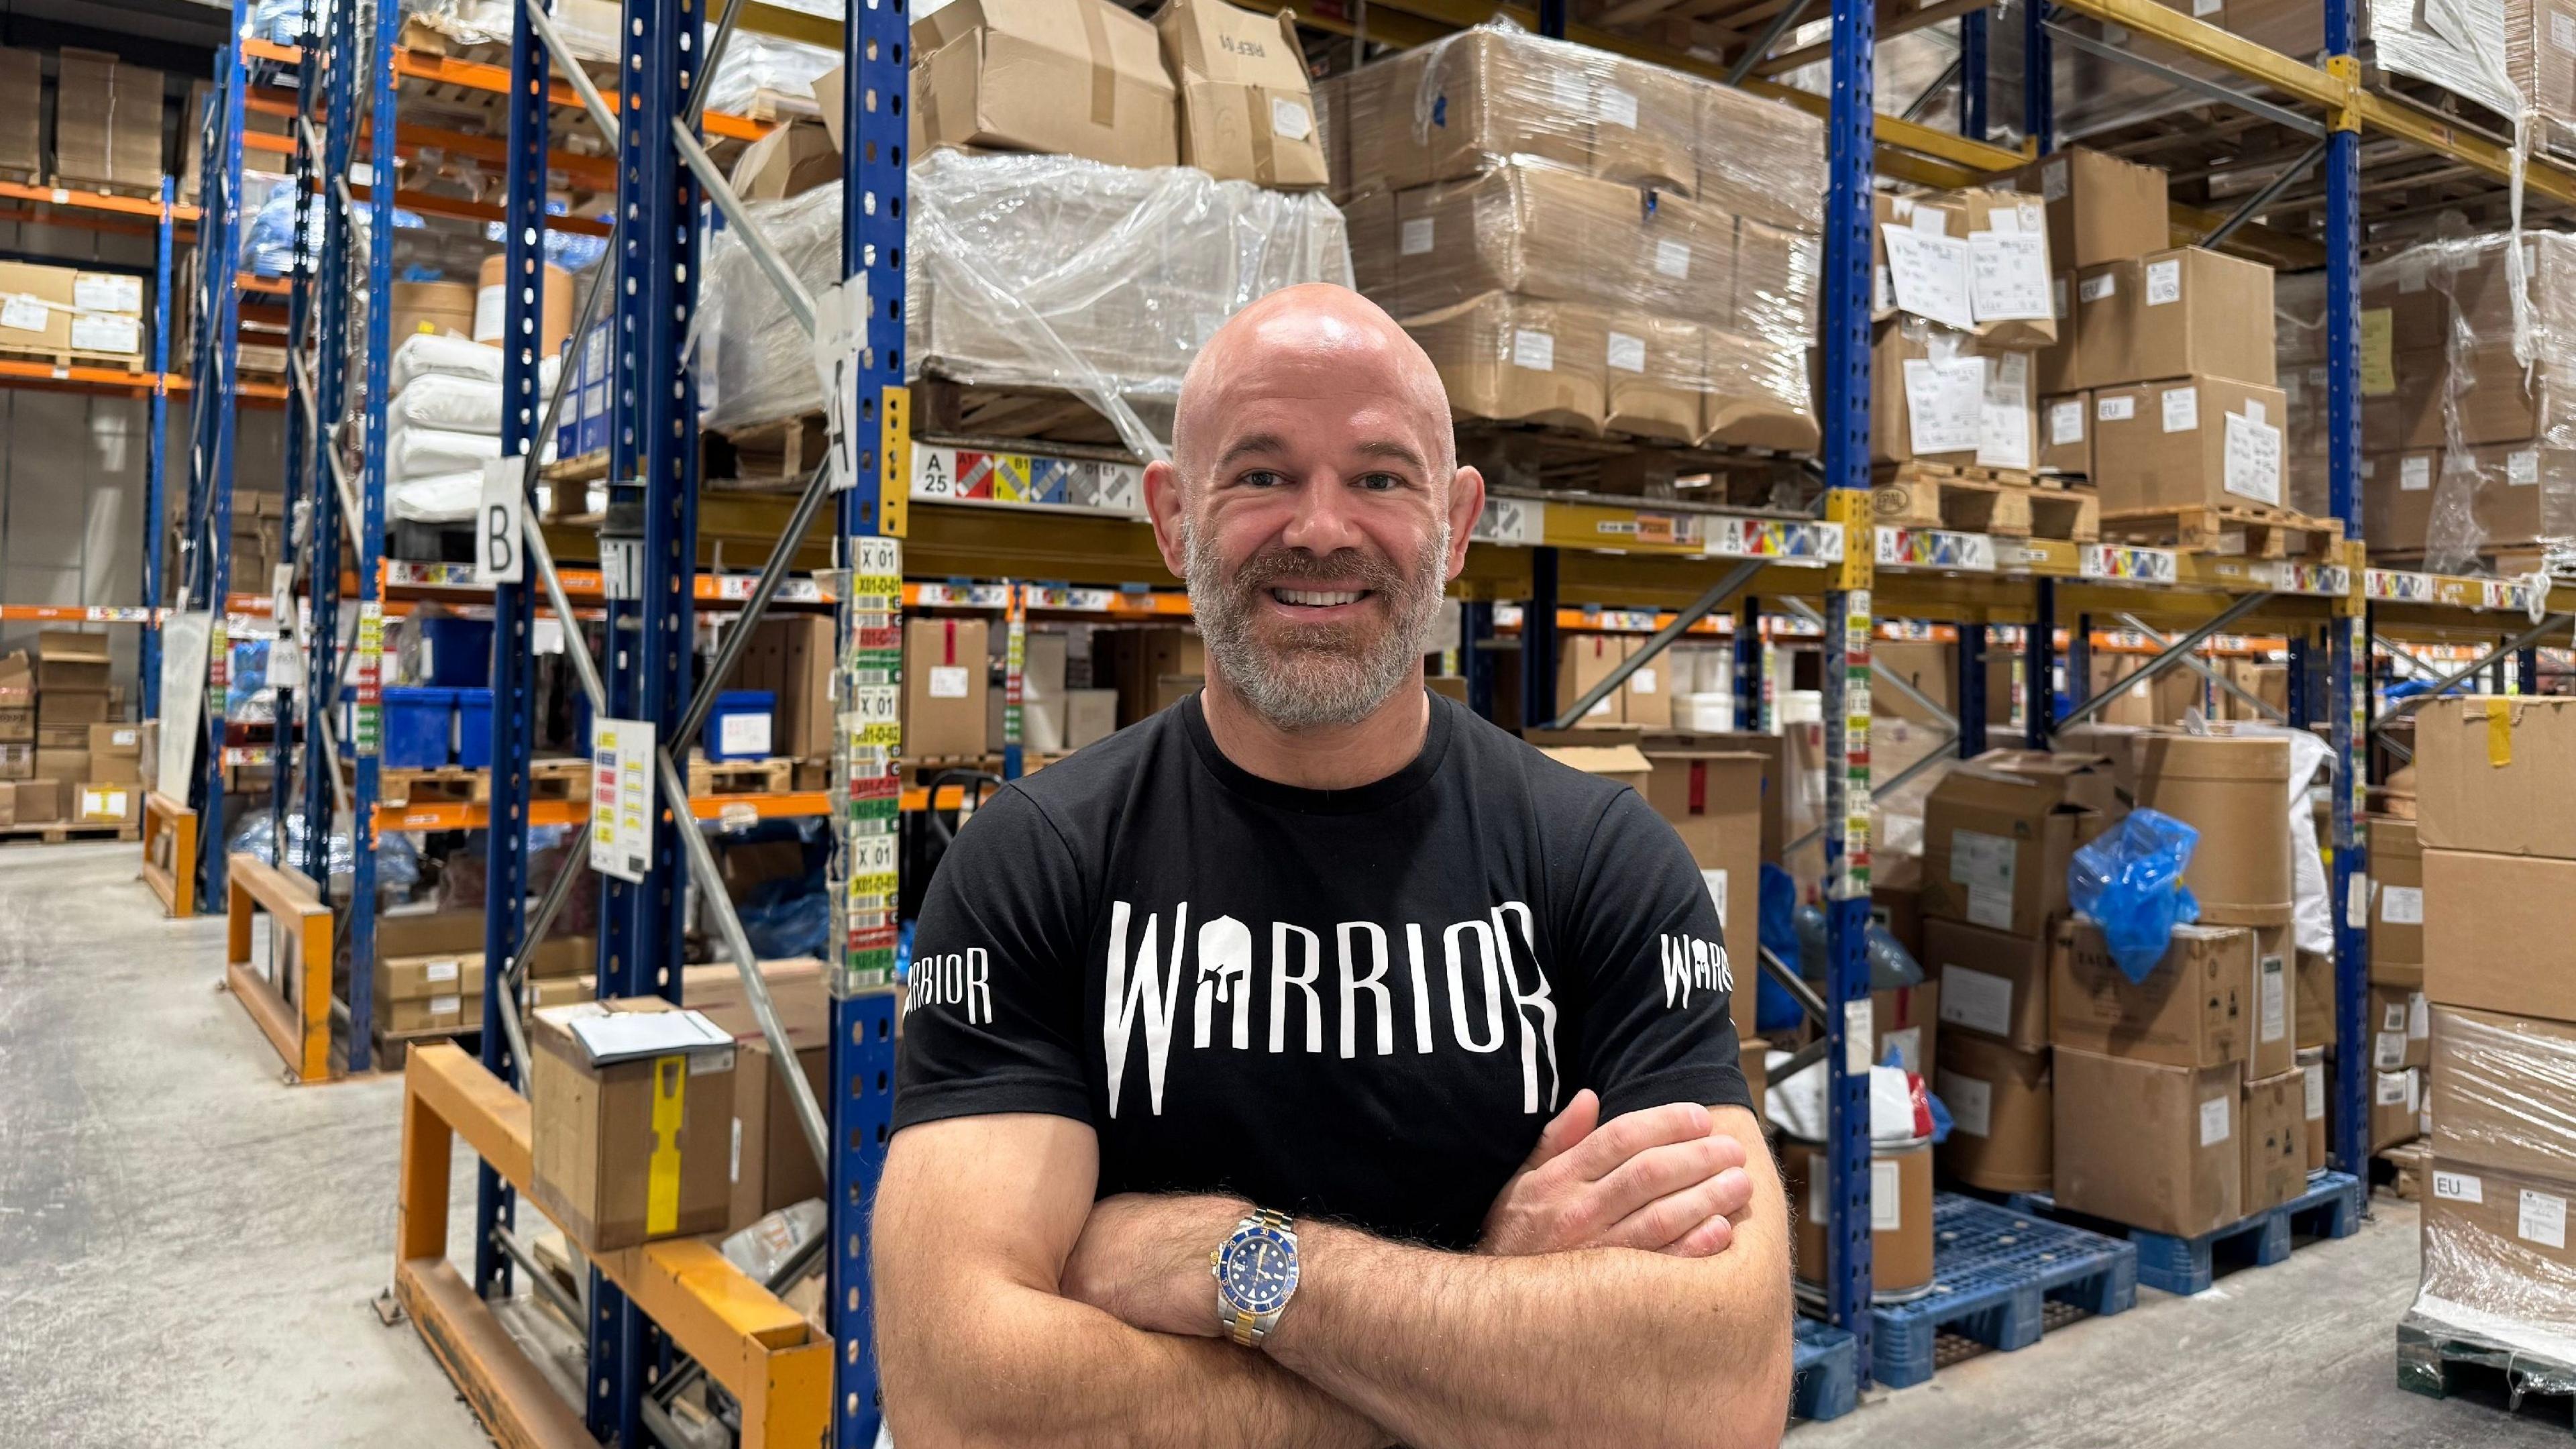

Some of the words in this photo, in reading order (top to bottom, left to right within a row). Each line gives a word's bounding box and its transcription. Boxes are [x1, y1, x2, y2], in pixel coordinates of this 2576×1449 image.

[927, 453, 942, 472] A
[1015, 459, 1029, 469] B1
[924, 474, 947, 492] 25
[489, 505, 513, 574] B
[863, 549, 871, 568] X
[879, 550, 895, 568] 01
[858, 578, 901, 594] X01-D-01
[861, 697, 869, 715] X
[877, 696, 893, 715] 01
[859, 847, 868, 866] X
[875, 847, 891, 865] 01
[1104, 901, 1559, 1118] WARRIOR
[2436, 1177, 2461, 1195] EU
